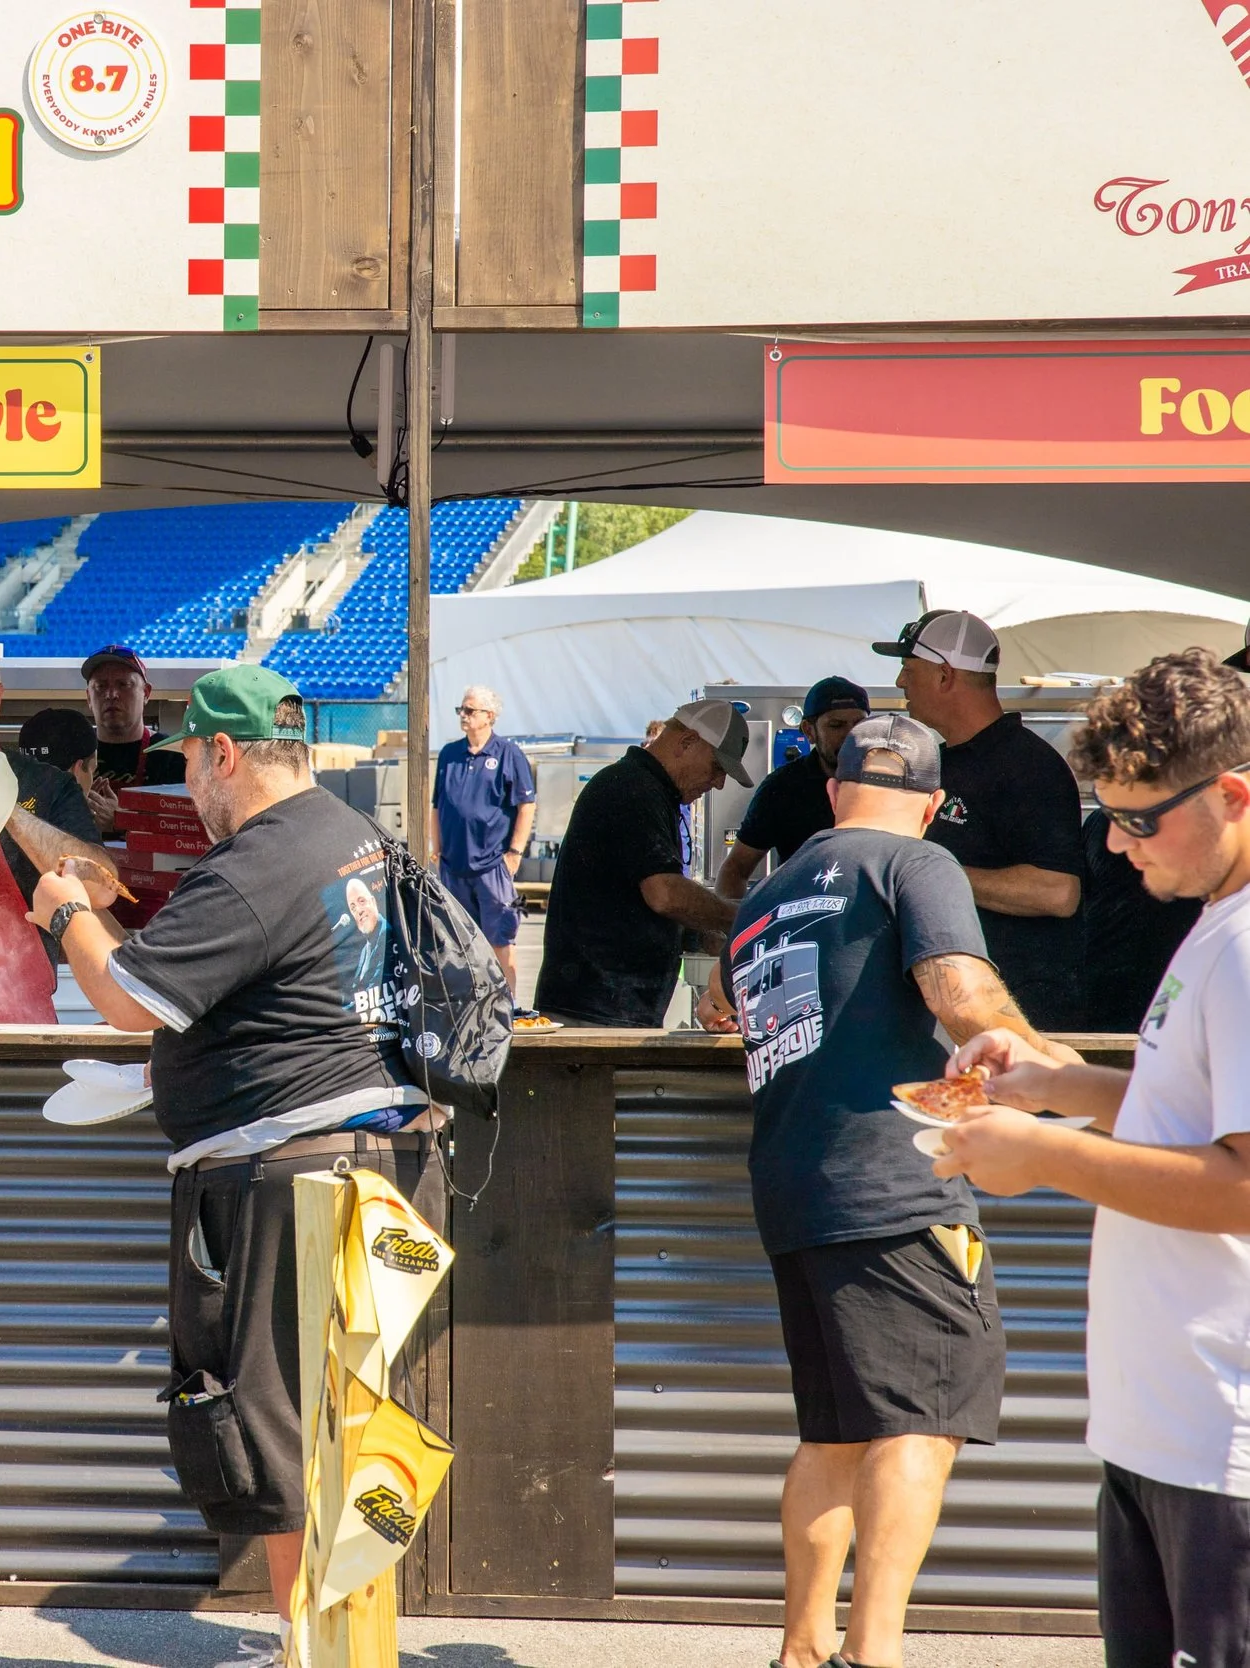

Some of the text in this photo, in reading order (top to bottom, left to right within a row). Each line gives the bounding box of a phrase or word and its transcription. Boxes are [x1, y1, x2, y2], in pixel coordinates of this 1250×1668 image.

[58, 20, 143, 49] ONE BITE
[71, 65, 128, 92] 8.7
[42, 73, 158, 137] EVERYBODY KNOWS THE RULES
[1094, 176, 1250, 256] Ton
[1215, 262, 1250, 280] TRA
[160, 799, 177, 809] Oven
[160, 820, 200, 832] Oven Fresh
[175, 839, 212, 851] Oven Fres
[372, 1247, 438, 1270] THE PIZZAMAN
[356, 1500, 371, 1514] THE
